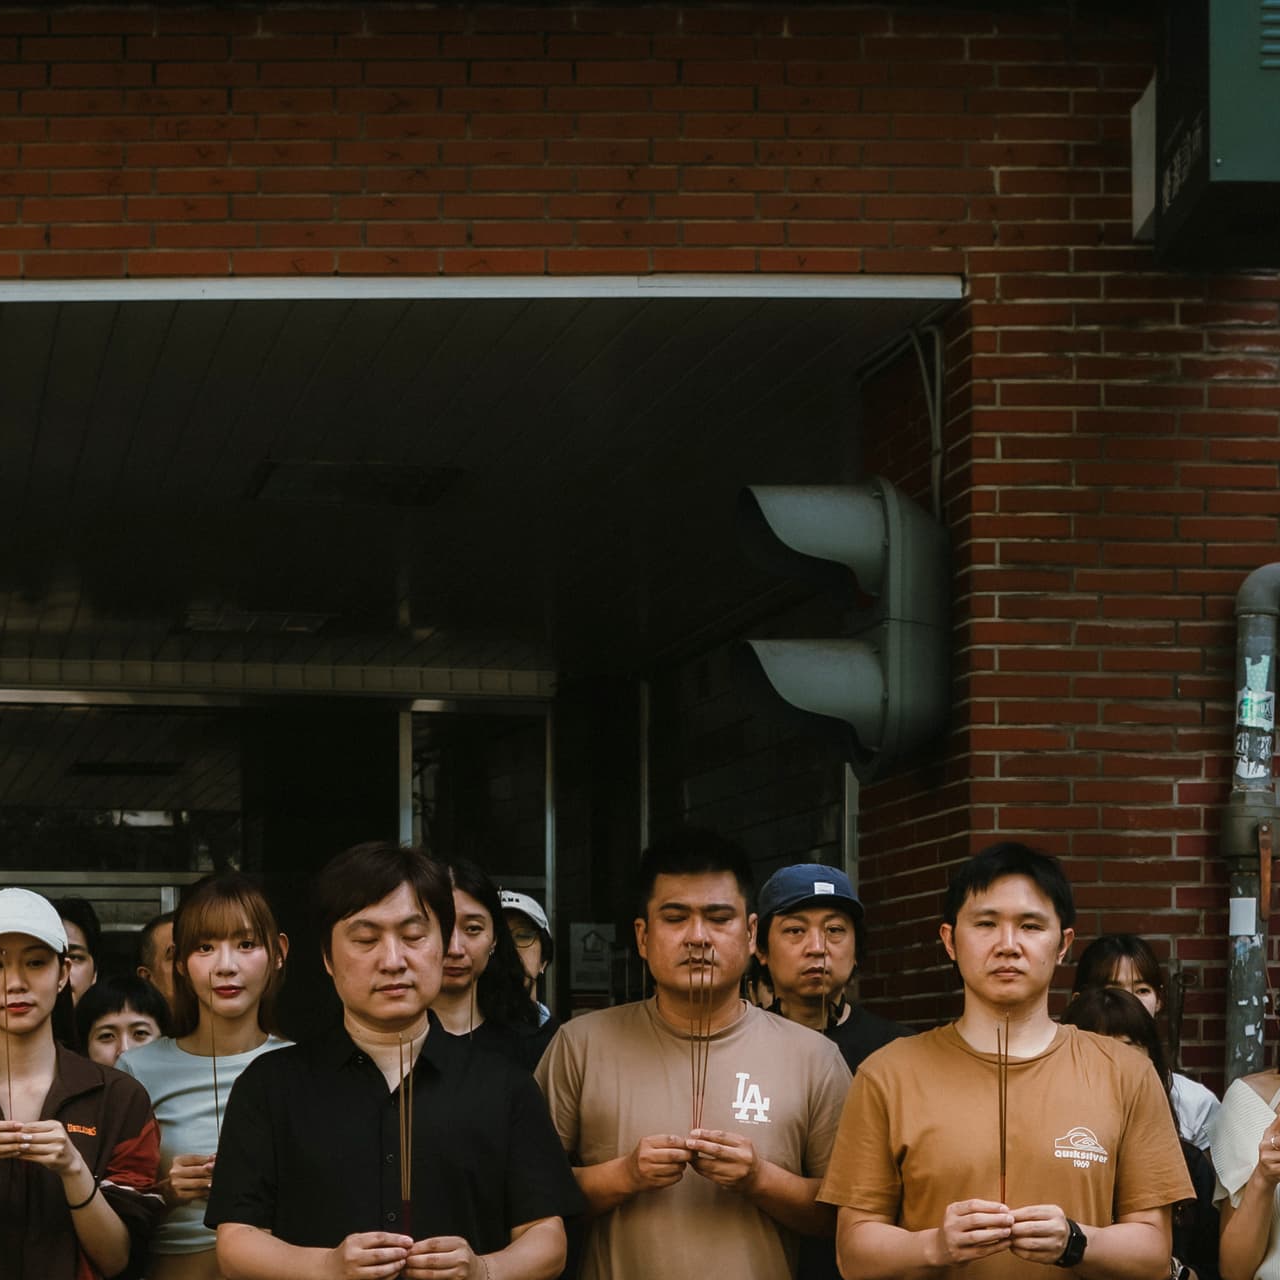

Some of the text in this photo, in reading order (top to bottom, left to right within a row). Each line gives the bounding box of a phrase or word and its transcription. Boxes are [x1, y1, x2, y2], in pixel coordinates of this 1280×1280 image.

[732, 1072, 770, 1122] LA
[1054, 1149, 1108, 1164] quiksilver
[1073, 1159, 1090, 1168] 1969
